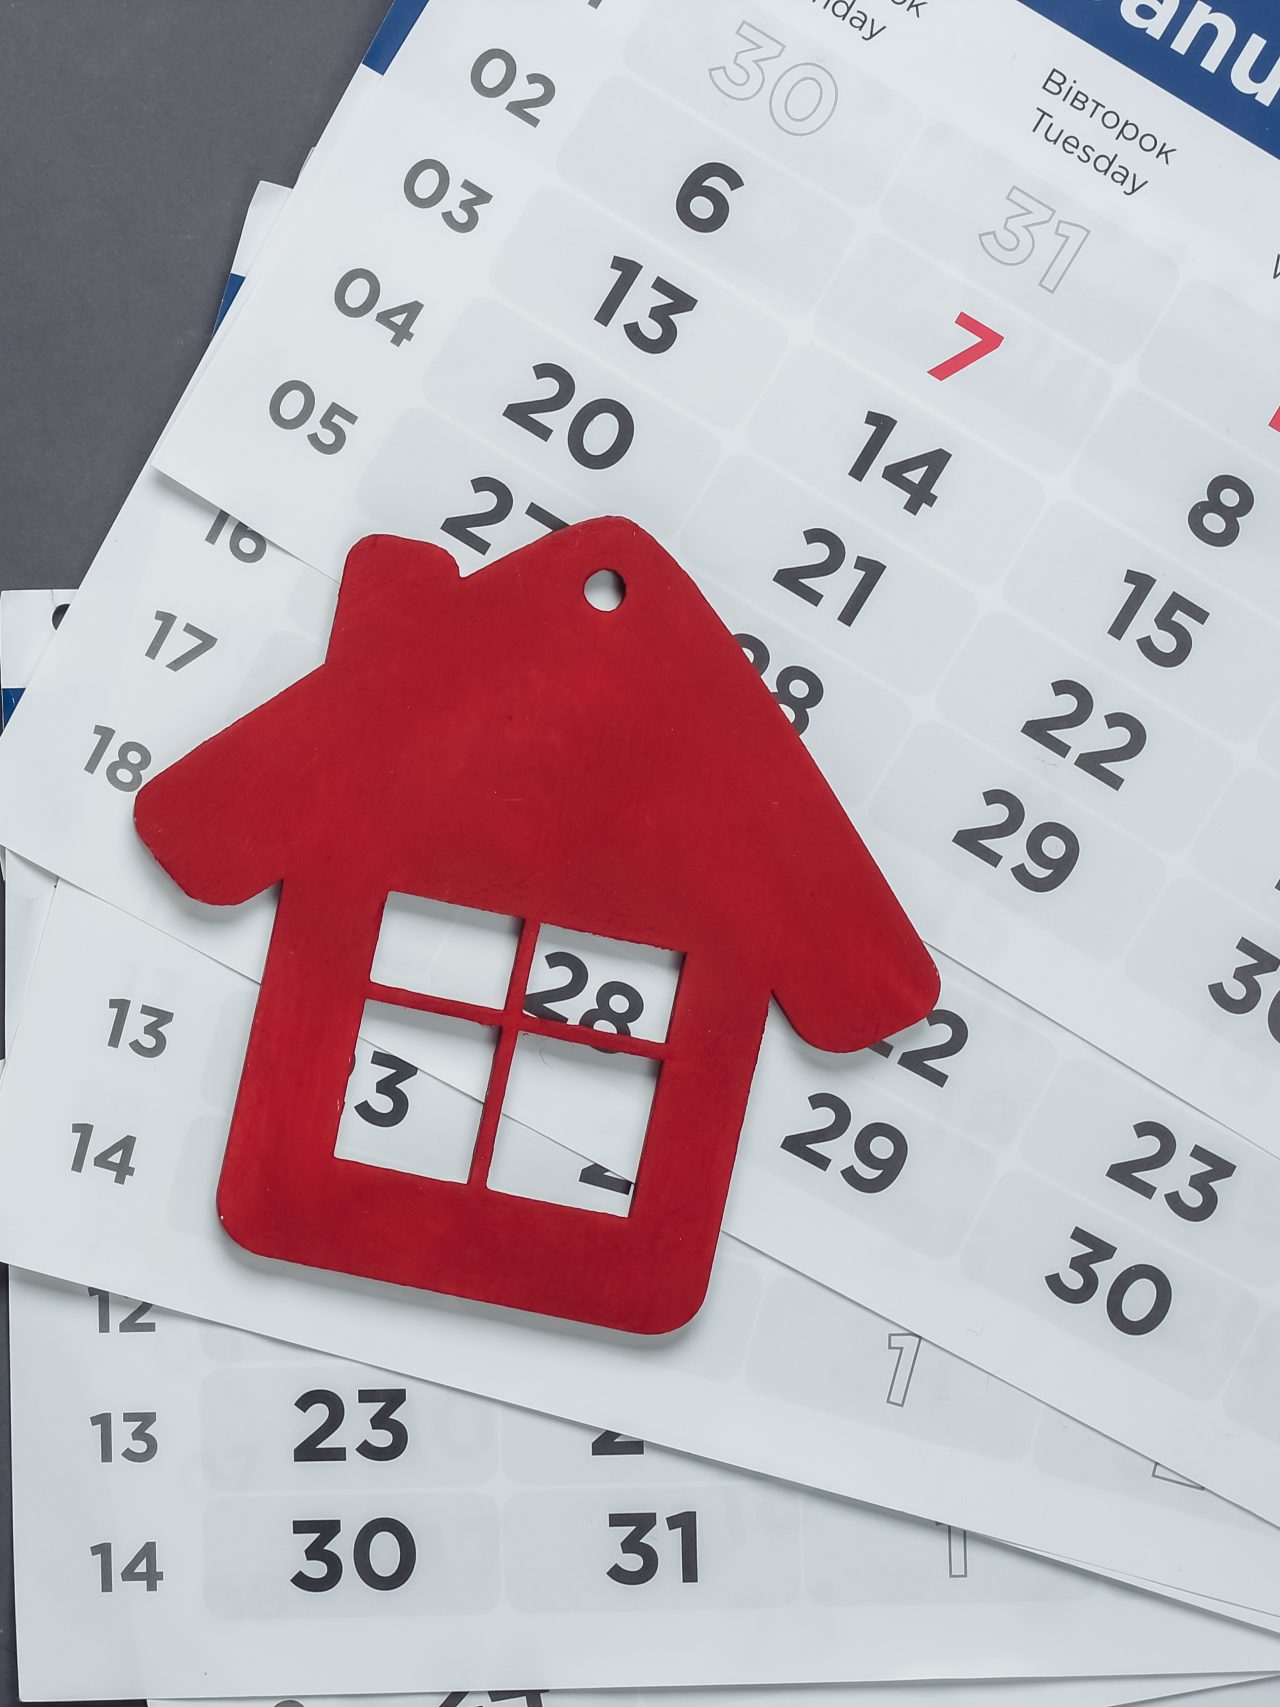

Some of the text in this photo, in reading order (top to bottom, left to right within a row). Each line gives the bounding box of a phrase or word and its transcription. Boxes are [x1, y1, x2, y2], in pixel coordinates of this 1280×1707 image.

[471, 48, 556, 128] 02
[708, 20, 839, 136] 30
[1041, 68, 1177, 166] Вівторок
[1032, 107, 1149, 196] Tuesday
[404, 159, 493, 233] 03
[676, 162, 744, 233] 6
[979, 186, 1090, 294] 31
[334, 268, 424, 347] 04
[594, 256, 698, 354] 13
[927, 312, 1004, 381] 7
[269, 380, 358, 455] 05
[502, 363, 634, 470] 20
[848, 411, 952, 516] 14
[1188, 475, 1254, 547] 8
[773, 528, 887, 628] 21
[145, 610, 218, 672] 17
[1107, 569, 1210, 668] 15
[84, 725, 151, 792] 18
[1021, 680, 1146, 791] 22
[952, 789, 1079, 893] 29
[108, 999, 174, 1058] 13
[522, 952, 644, 1054] 28
[1208, 936, 1280, 1043] 3
[867, 1009, 968, 1088] 2
[71, 1123, 136, 1185] 14
[780, 1093, 908, 1193] 29
[1106, 1121, 1237, 1222] 23
[1045, 1226, 1172, 1336] 30
[886, 1333, 921, 1407] 1
[90, 1412, 157, 1462] 13
[294, 1389, 408, 1462] 23
[90, 1542, 163, 1592] 14
[290, 1518, 416, 1592] 30
[607, 1511, 699, 1585] 31
